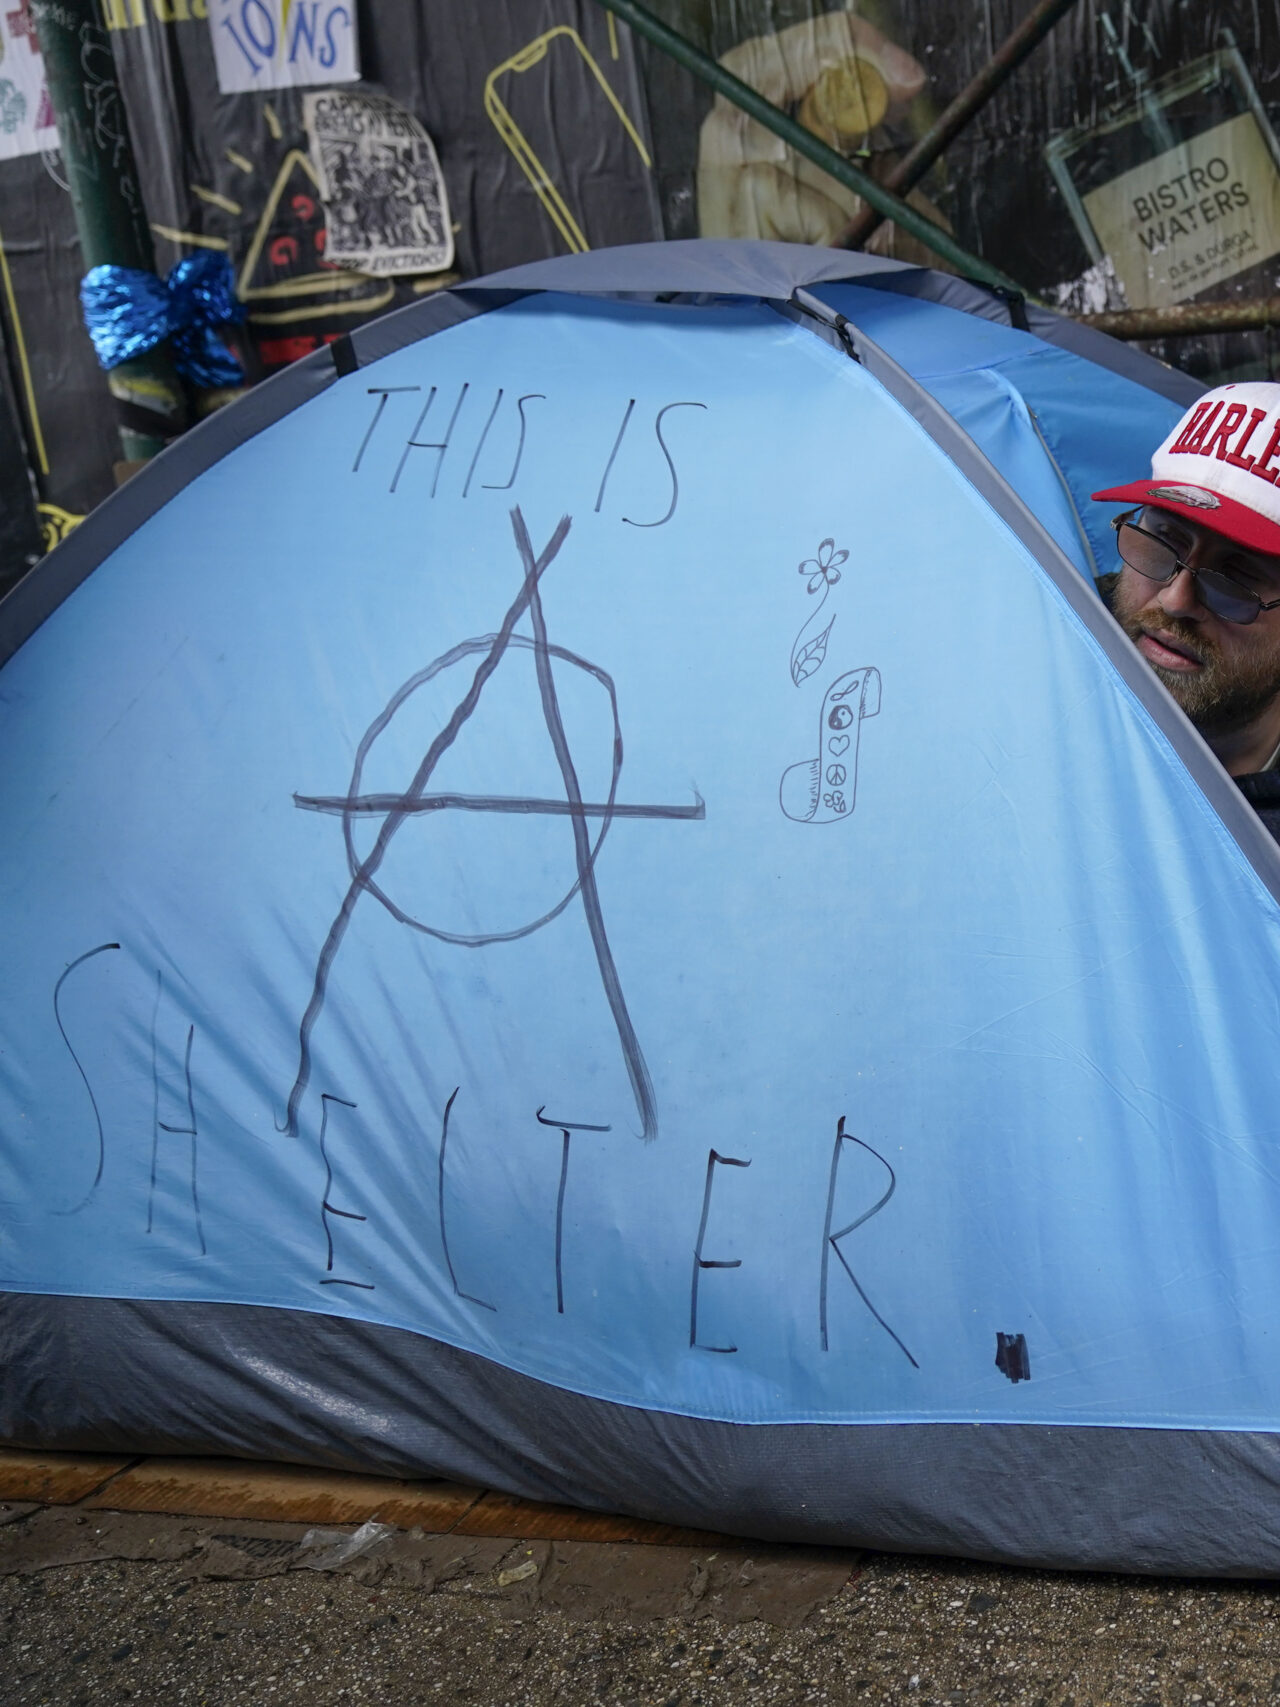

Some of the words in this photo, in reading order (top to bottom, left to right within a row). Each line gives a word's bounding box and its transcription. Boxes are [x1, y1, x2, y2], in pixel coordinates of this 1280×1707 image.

[1132, 157, 1229, 223] BISTRO
[1138, 181, 1250, 252] WATERS
[352, 382, 547, 499] THIS
[594, 398, 708, 528] IS
